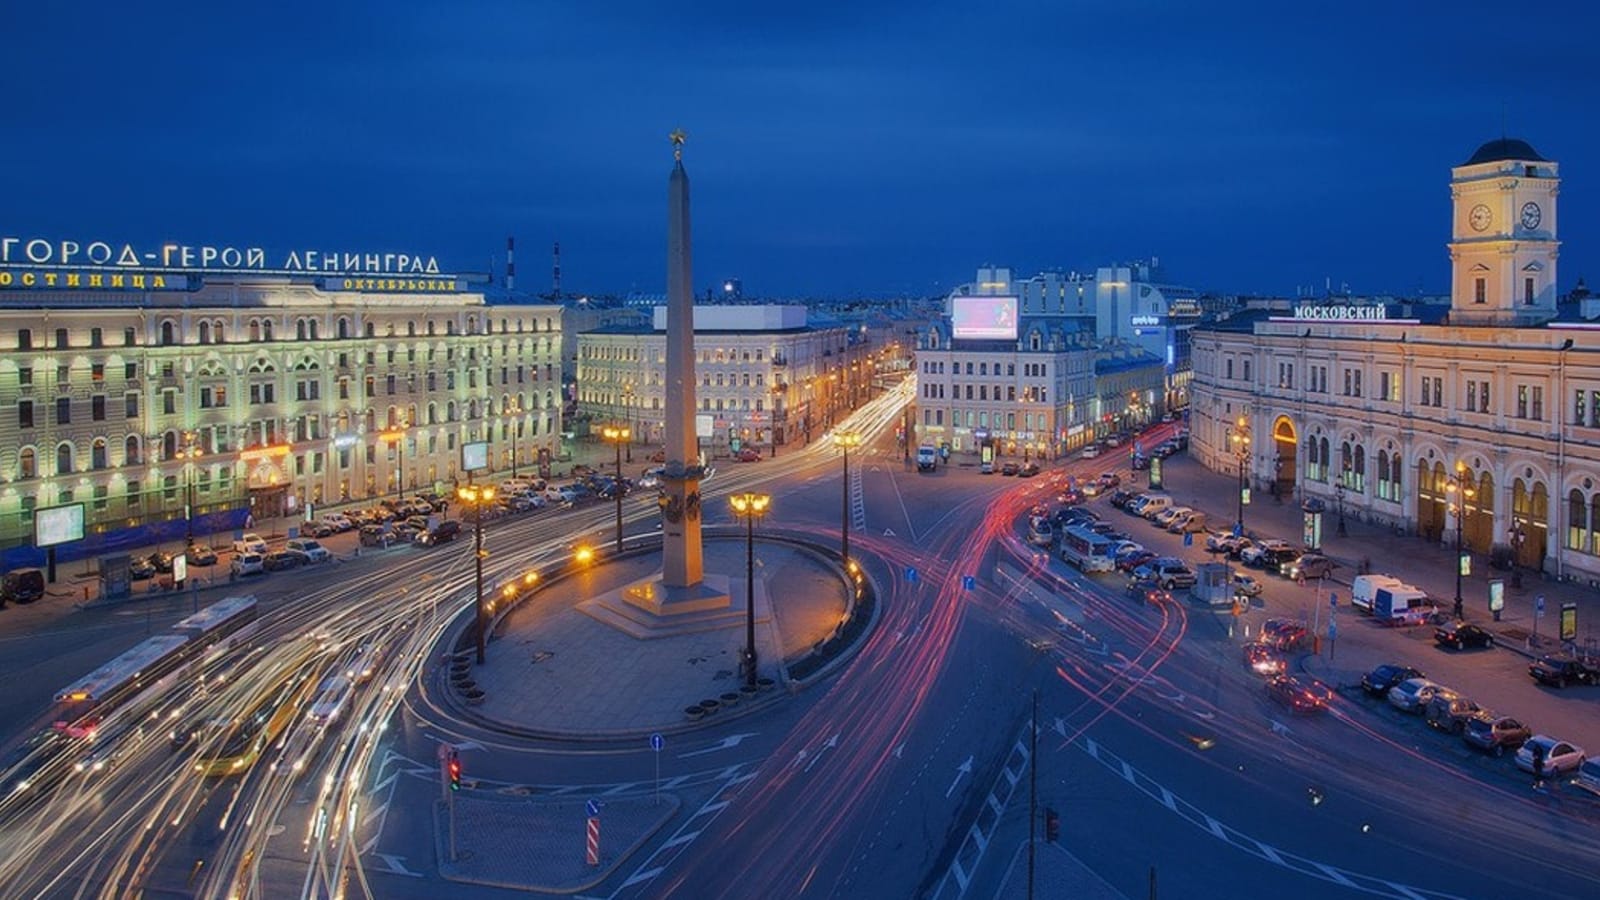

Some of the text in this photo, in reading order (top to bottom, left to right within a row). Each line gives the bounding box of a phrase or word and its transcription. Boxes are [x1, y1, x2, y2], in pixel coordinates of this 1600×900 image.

[2, 238, 440, 274] ГОРОД-ГЕРОЙ ЛЕНИНГРАД
[343, 278, 456, 291] ОКТЯБРЬСКАЯ
[1294, 302, 1386, 320] МОСКОВСКИЙ
